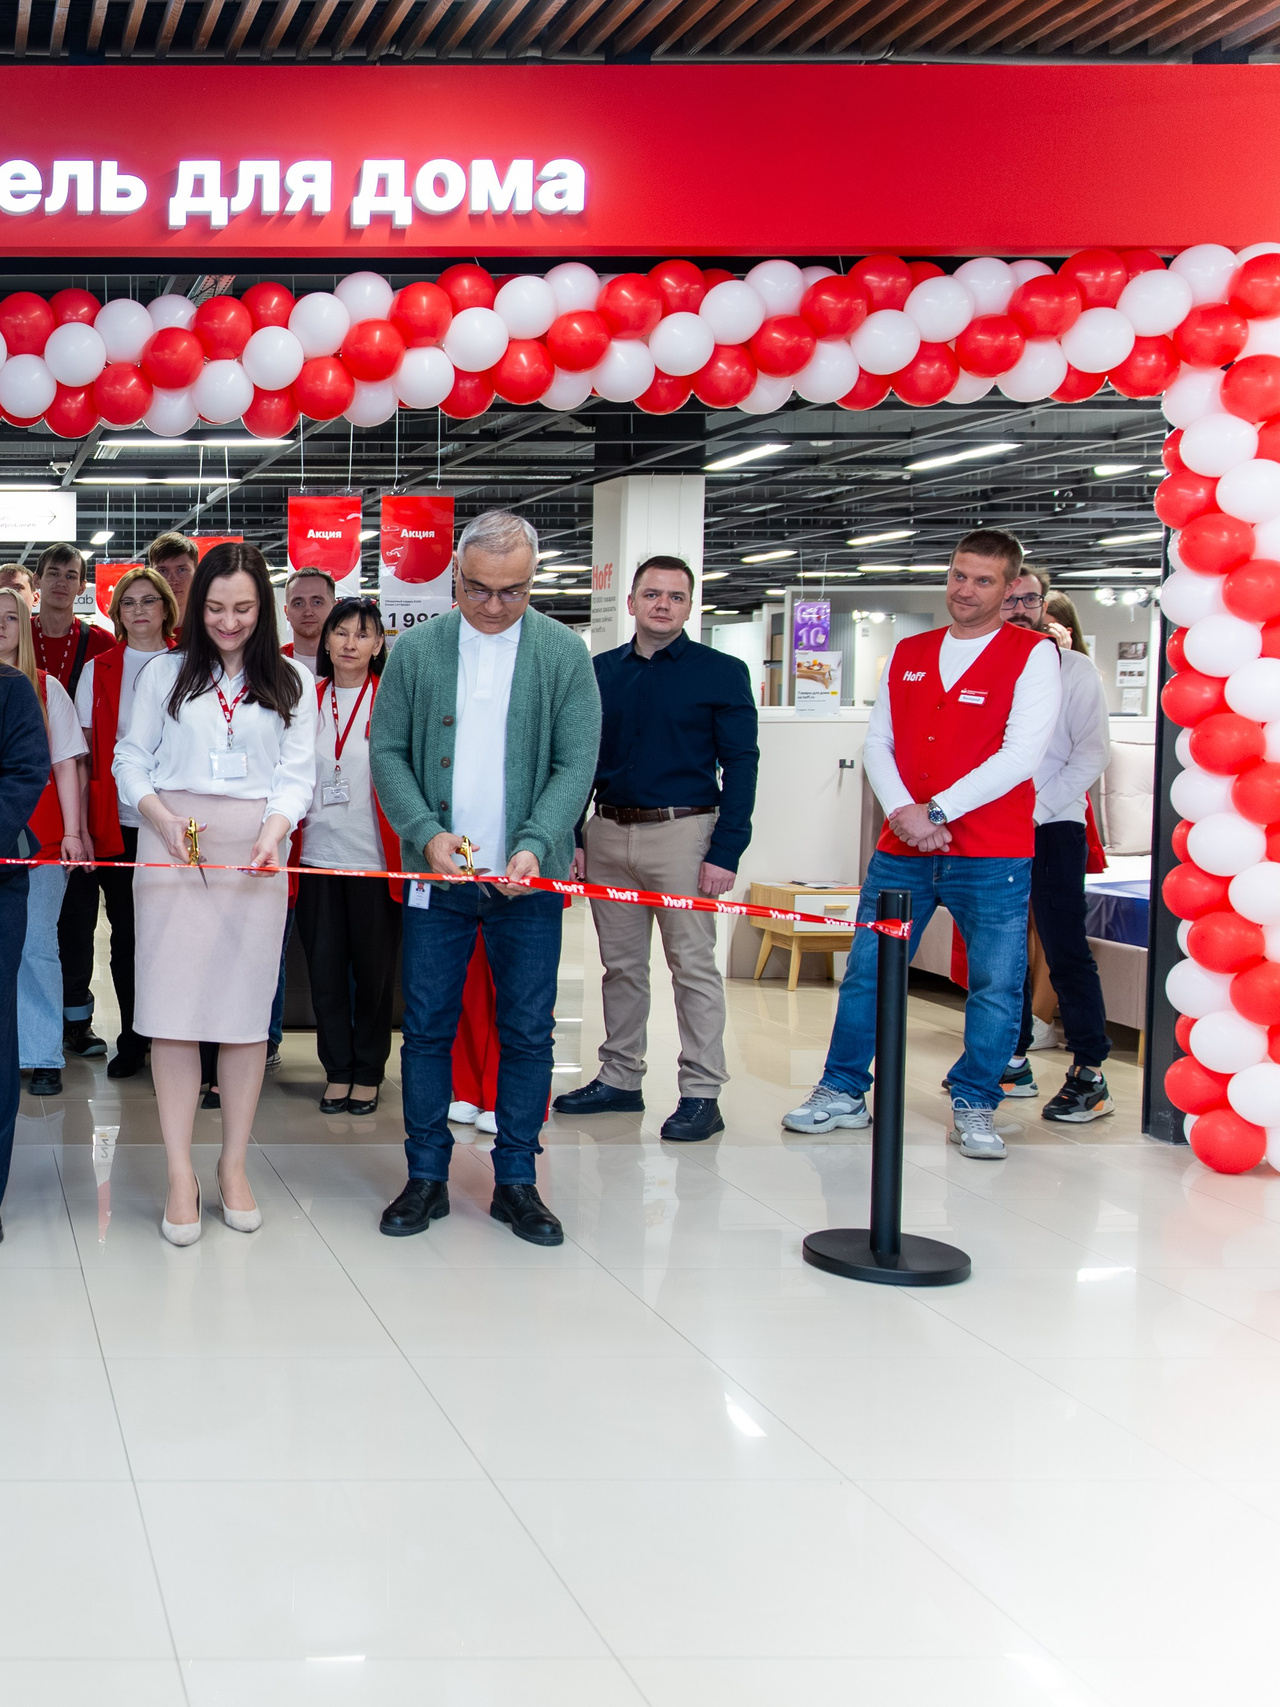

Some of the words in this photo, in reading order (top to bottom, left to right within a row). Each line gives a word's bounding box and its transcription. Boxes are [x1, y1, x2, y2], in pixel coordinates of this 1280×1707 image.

[169, 159, 332, 229] для
[351, 158, 587, 229] дома
[307, 529, 342, 539] Акция
[401, 529, 435, 539] Акция
[592, 563, 613, 590] Hoff
[389, 612, 396, 628] 1
[403, 612, 440, 629] 99
[902, 671, 927, 682] Hoff
[552, 881, 585, 894] Hoff
[606, 888, 639, 902] Hoff
[661, 895, 694, 909] Hoff
[715, 903, 747, 915] Hoff
